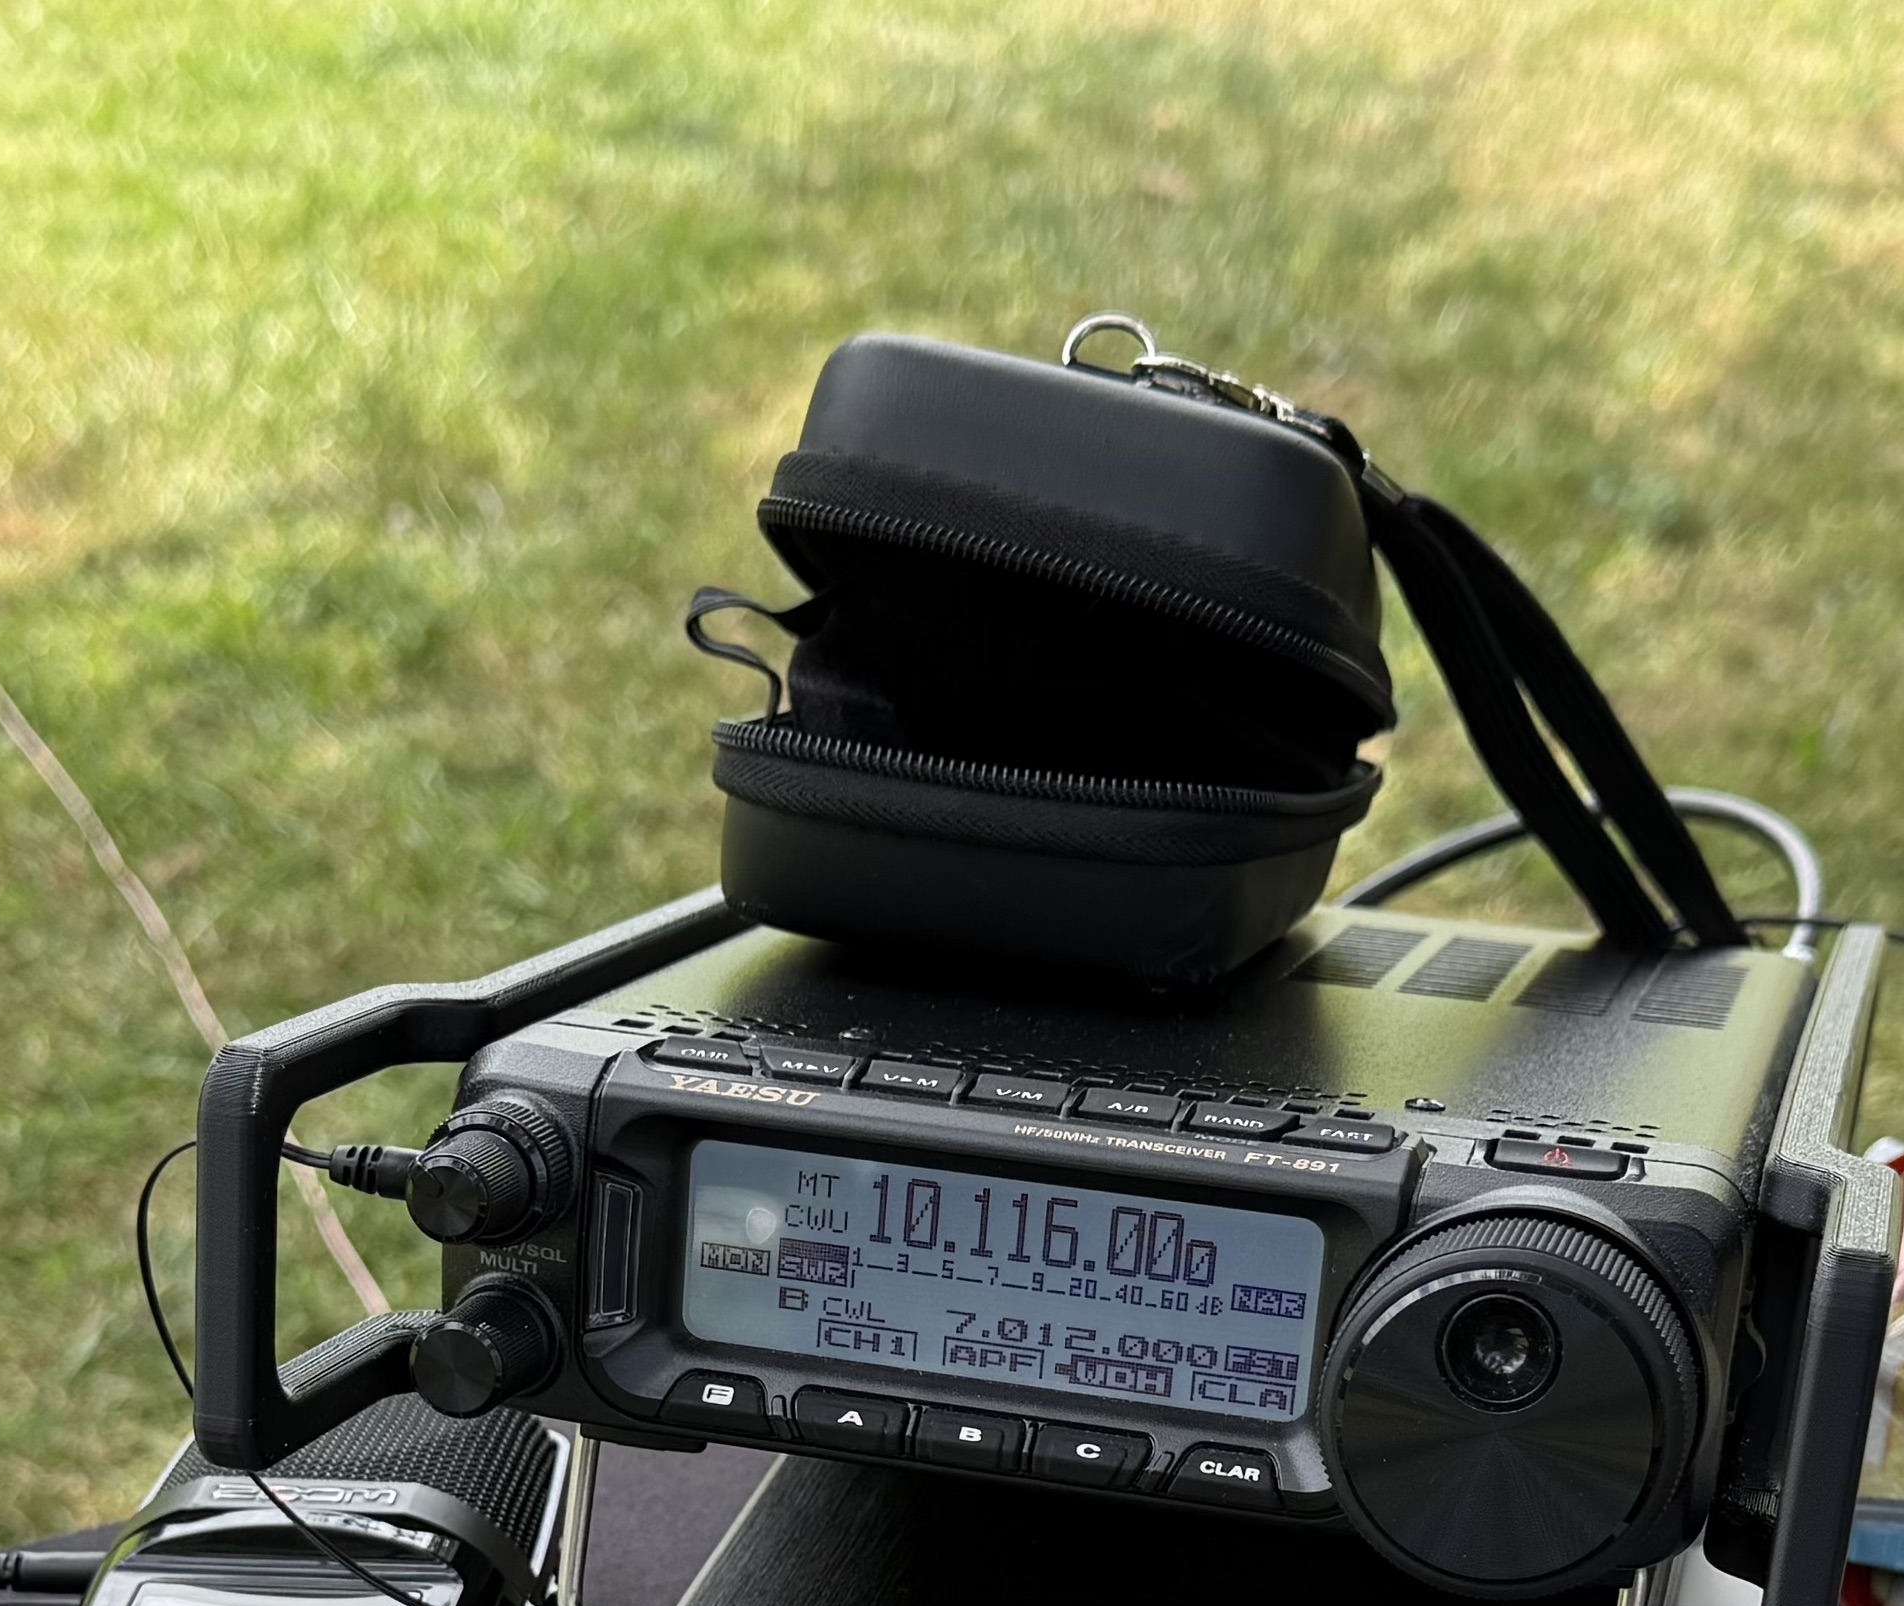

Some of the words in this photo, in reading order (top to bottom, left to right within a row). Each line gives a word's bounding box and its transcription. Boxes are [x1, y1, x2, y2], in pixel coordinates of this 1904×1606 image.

[669, 1074, 821, 1106] YAESU
[1013, 1123, 1101, 1146] HF/50MHz
[1104, 1135, 1228, 1162] TRANSCEIVER
[1243, 1152, 1341, 1175] FT-891
[797, 1170, 840, 1198] MT
[784, 1203, 849, 1234] CWU
[869, 1173, 1218, 1287] 10.116.000
[479, 1250, 538, 1275] MULTI
[823, 1297, 886, 1323] CWL
[824, 1326, 906, 1356] CH1
[949, 1345, 1038, 1372] APF
[1198, 1379, 1288, 1411] CLA
[836, 1409, 865, 1427] A
[958, 1426, 983, 1443] B
[1075, 1442, 1102, 1460] C
[1198, 1459, 1263, 1484] CLAR
